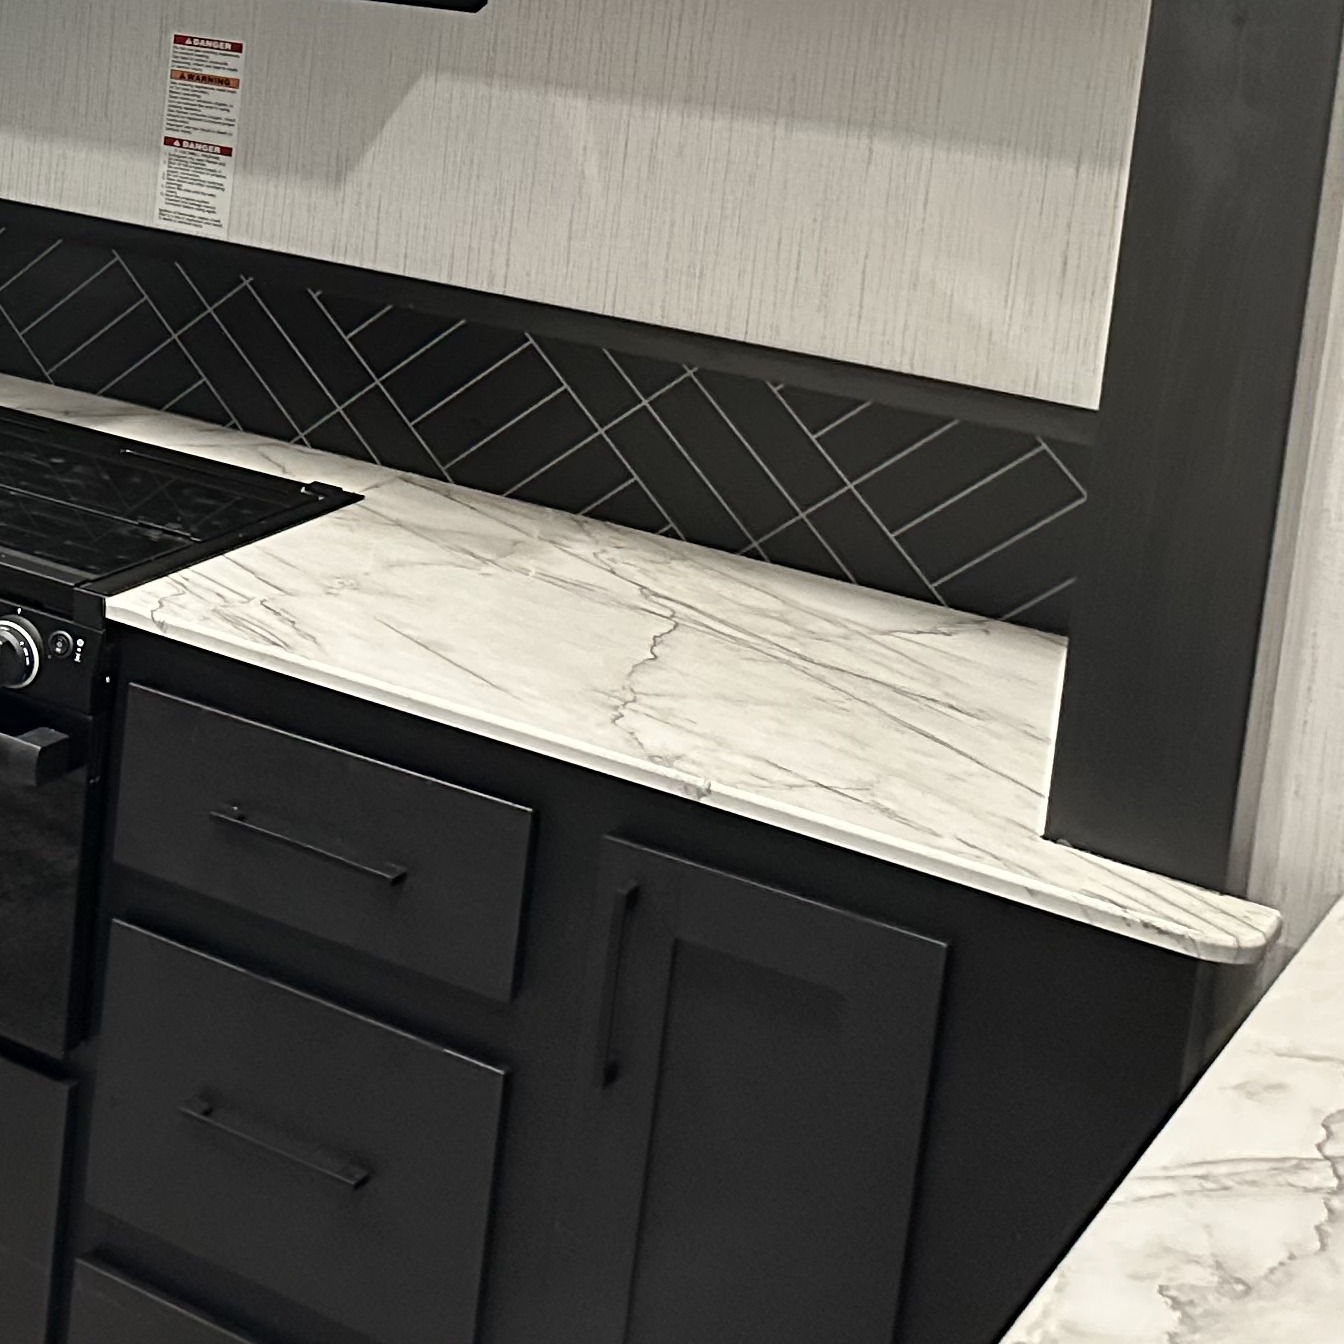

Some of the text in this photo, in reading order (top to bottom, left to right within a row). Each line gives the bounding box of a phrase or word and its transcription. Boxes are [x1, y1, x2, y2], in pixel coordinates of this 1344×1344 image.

[192, 38, 232, 51] DANGER
[187, 73, 231, 86] WARNING
[182, 140, 221, 154] DANGER
